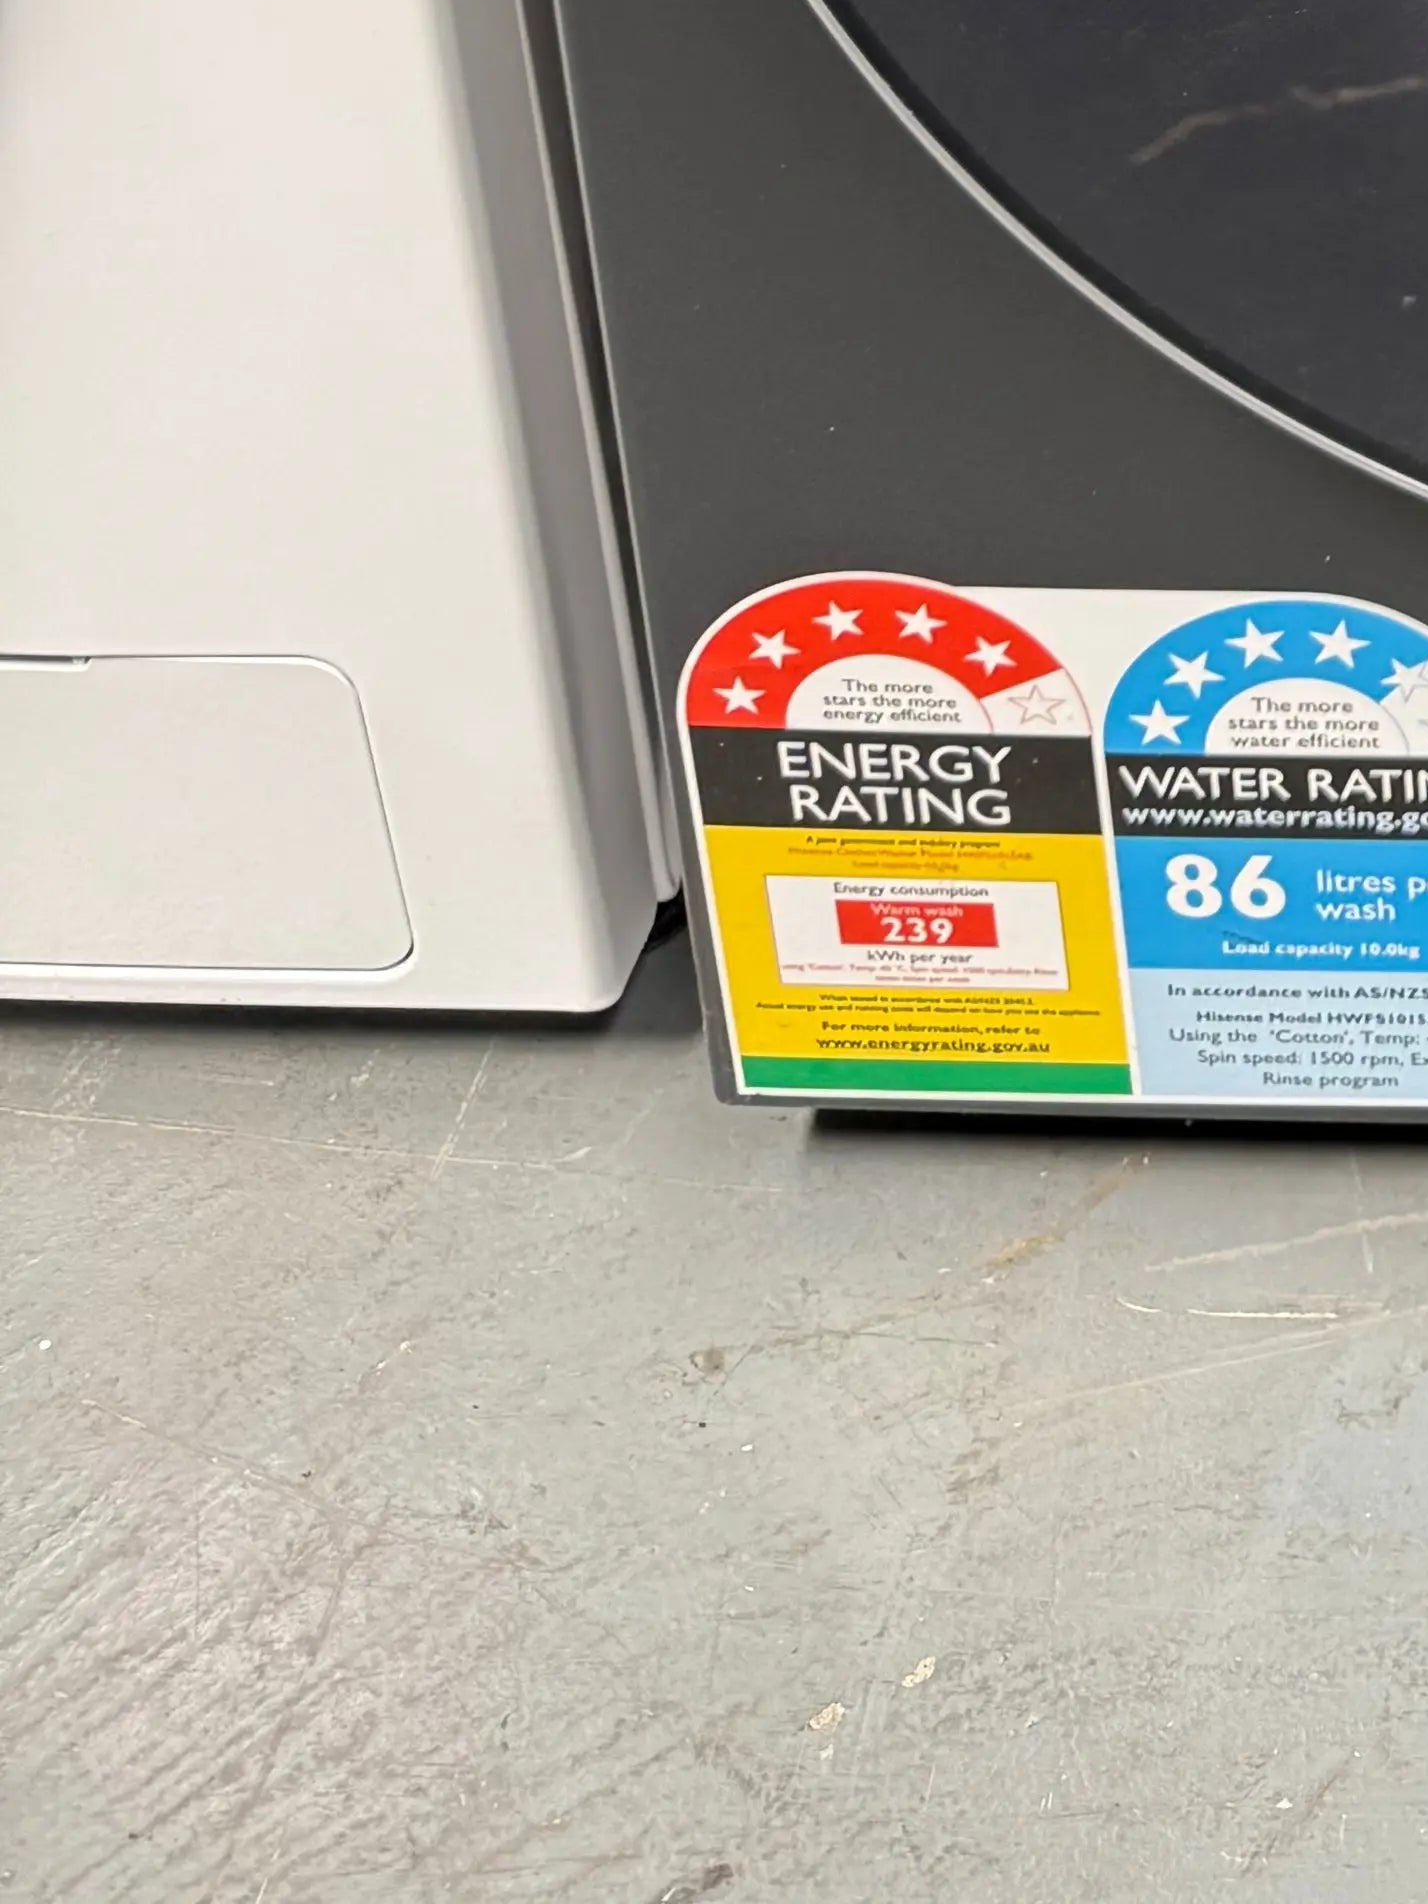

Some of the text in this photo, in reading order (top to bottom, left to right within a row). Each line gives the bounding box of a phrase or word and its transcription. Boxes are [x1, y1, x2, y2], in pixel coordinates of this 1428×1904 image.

[842, 679, 933, 694] The more
[823, 695, 957, 709] stars the more
[1251, 697, 1353, 714] The more
[823, 710, 962, 724] energy efficient
[1229, 717, 1379, 732] stars the more
[1231, 734, 1379, 749] water efficient
[777, 741, 1012, 785] ENERGY
[1118, 765, 1292, 802] WATER
[790, 784, 1011, 826] RATING
[834, 882, 988, 899] Energy consumption
[1166, 853, 1286, 919] 86
[1316, 870, 1396, 893] litres
[871, 903, 921, 917] Warm
[1316, 898, 1396, 921] wash
[881, 917, 954, 944] 239
[868, 950, 973, 965] kWh per year
[1222, 941, 1353, 958] Load capacity
[1192, 984, 1301, 998] accordance
[1308, 985, 1350, 999] with
[1196, 1011, 1322, 1024] Hisense Model
[816, 1038, 1050, 1054] www.energyrating.gov.au
[1169, 1029, 1222, 1045] Using
[1228, 1030, 1257, 1043] the
[1360, 1031, 1420, 1047] Temp:
[1198, 1051, 1236, 1066] Spin
[1311, 1052, 1354, 1065] 1500
[1263, 1072, 1399, 1089] Rinse program
